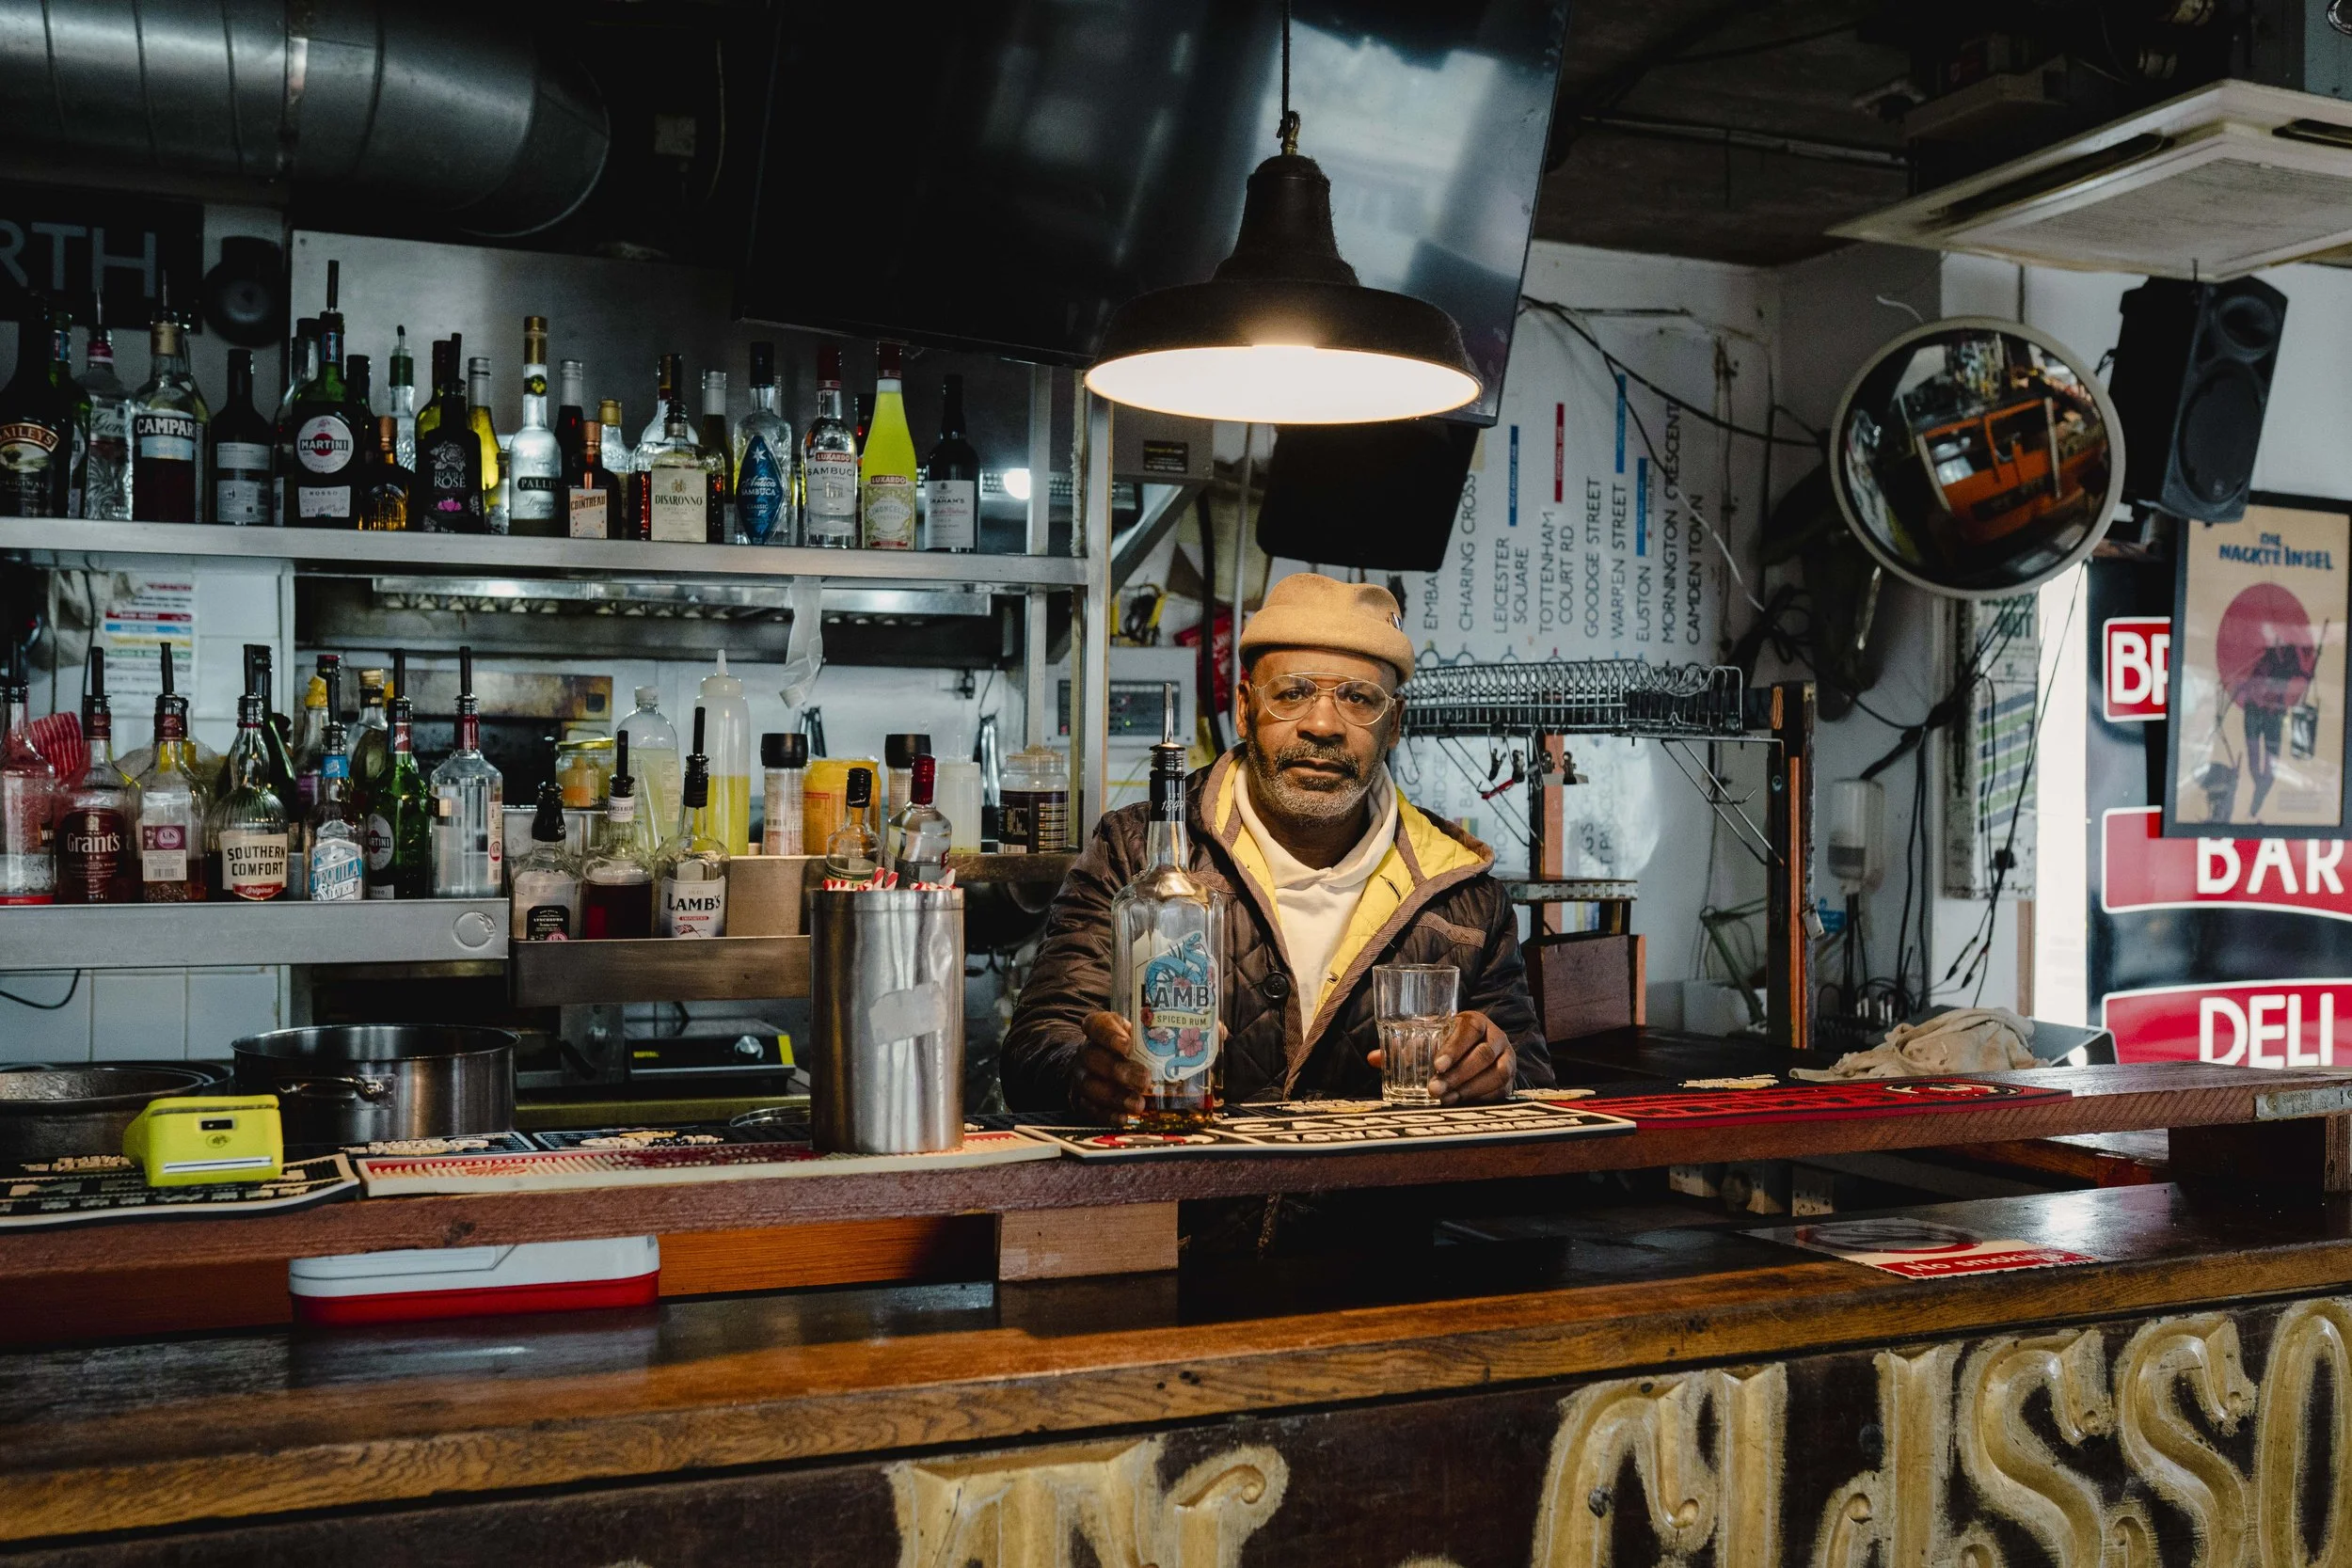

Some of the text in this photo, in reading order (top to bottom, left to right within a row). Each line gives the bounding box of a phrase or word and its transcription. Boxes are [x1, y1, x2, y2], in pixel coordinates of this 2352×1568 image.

[0, 427, 54, 446] AILEYS
[300, 438, 348, 451] MARTINI
[816, 452, 851, 462] LUXARDO
[434, 476, 466, 489] ROSE
[435, 471, 466, 480] TEQUILA
[807, 467, 855, 477] SAMBUCA
[871, 476, 906, 484] LUXARDO
[655, 495, 703, 506] DISARONNO
[740, 487, 776, 497] SAMBUCA
[570, 495, 606, 511] COINTREAU
[1662, 401, 1682, 643] MORNINGTON CRESCENT
[2260, 532, 2282, 546] DIE
[1458, 474, 1477, 632] CHARING CROSS
[1585, 477, 1601, 638] GOODGE STREET
[1611, 483, 1627, 640] WARREN STREET
[2218, 544, 2334, 571] NACKTE INSEL
[1539, 511, 1555, 635] TOTTENHAM
[1687, 495, 1703, 645] CAMDEN TOWN
[1494, 537, 1509, 634] LEICESTER
[1513, 546, 1529, 625] SQUARE
[1559, 559, 1574, 626] COURT
[1423, 572, 1439, 631] EMBA
[1636, 565, 1651, 642] EUSTON
[67, 832, 120, 853] Grant's
[228, 845, 285, 861] SOUTHERN
[231, 863, 284, 877] COMFORT
[311, 860, 360, 890] TEQUILA
[246, 885, 276, 895] Original
[317, 879, 358, 900] SILVER
[667, 892, 722, 911] LAMB'S
[1141, 983, 1216, 1009] LAMB'S
[1157, 1014, 1207, 1027] SPICED RUM
[2200, 992, 2334, 1070] DELI
[1233, 1107, 1548, 1132] CAMDEN
[1275, 1117, 1583, 1143] TOWN BREWERY
[1903, 1251, 2066, 1273] No smoking
